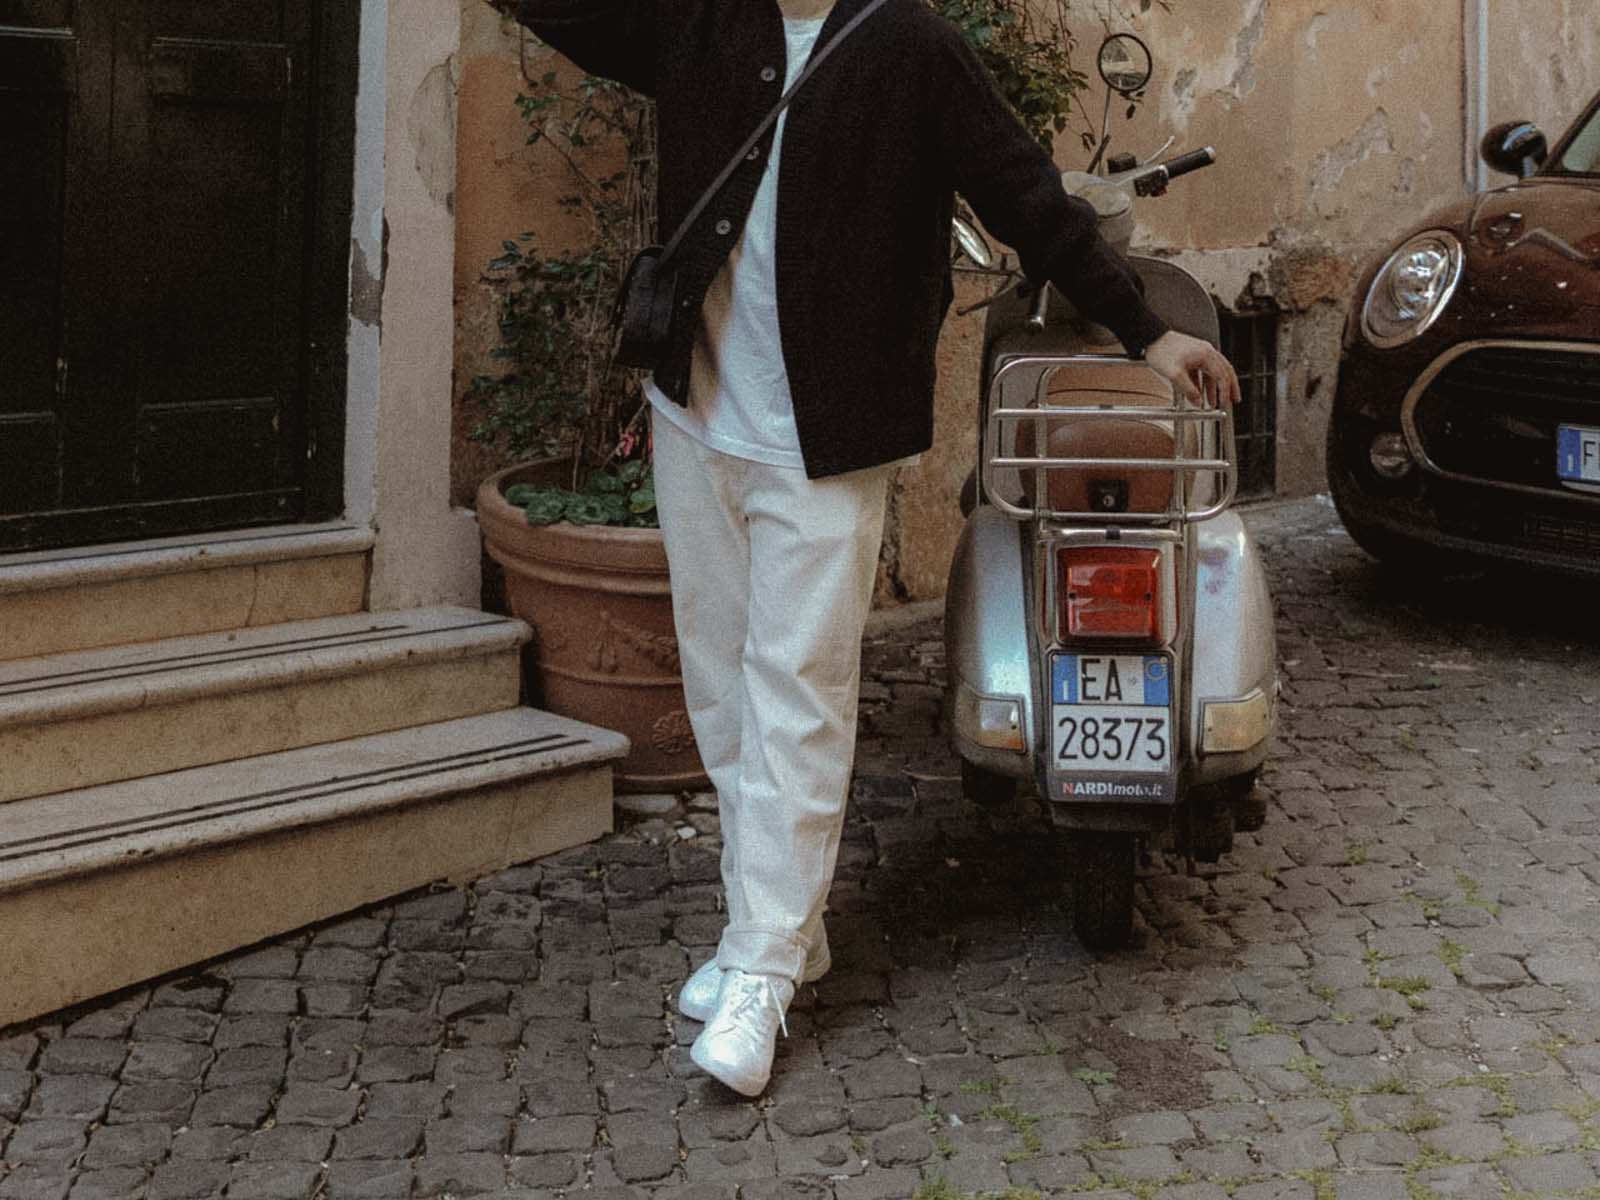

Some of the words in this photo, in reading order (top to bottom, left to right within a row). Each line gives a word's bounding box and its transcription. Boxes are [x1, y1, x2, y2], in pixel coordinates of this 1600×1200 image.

[1583, 440, 1600, 468] F
[1081, 658, 1122, 701] EA
[1058, 717, 1165, 761] 28373
